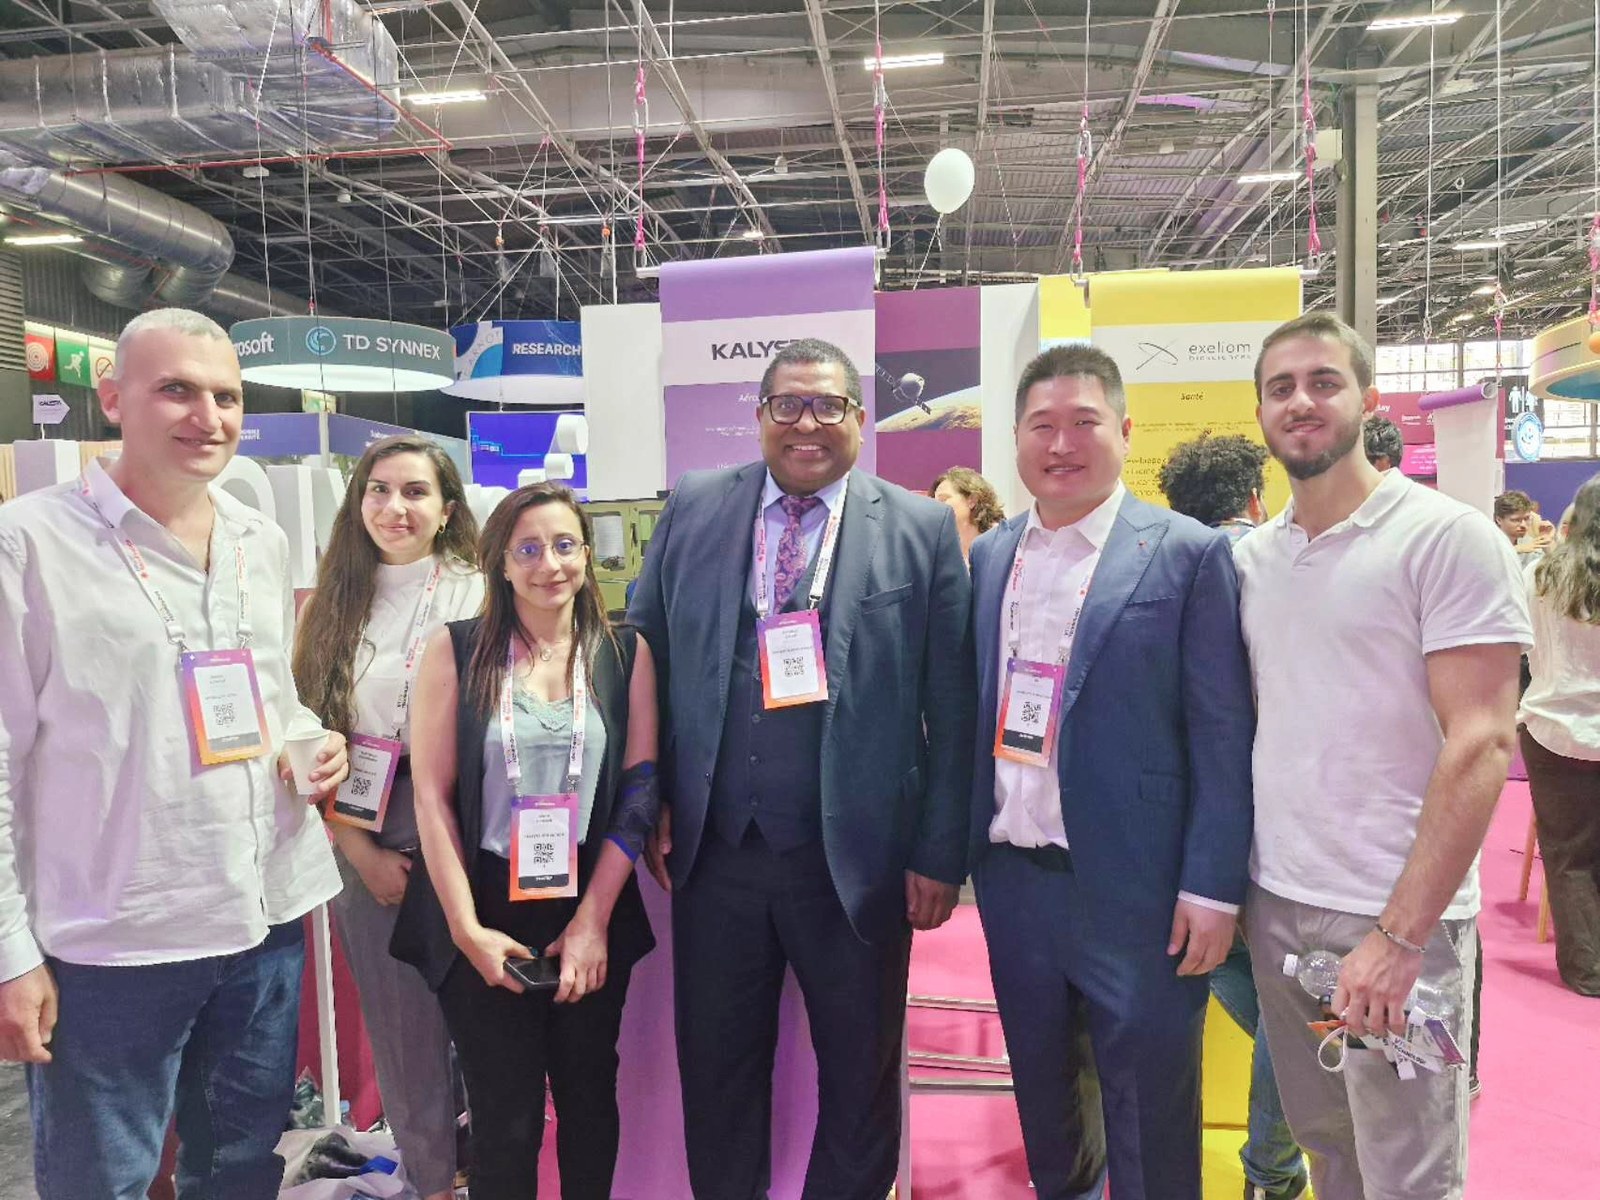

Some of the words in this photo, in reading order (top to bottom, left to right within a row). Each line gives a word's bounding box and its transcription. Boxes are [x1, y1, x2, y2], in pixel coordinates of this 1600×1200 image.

[235, 331, 275, 357] osoft
[343, 334, 371, 350] TD
[376, 337, 441, 361] SYNNEX
[512, 342, 581, 356] RESEARCH
[711, 339, 801, 361] KALYS
[1189, 340, 1250, 355] exeliom
[1180, 391, 1204, 402] Santé
